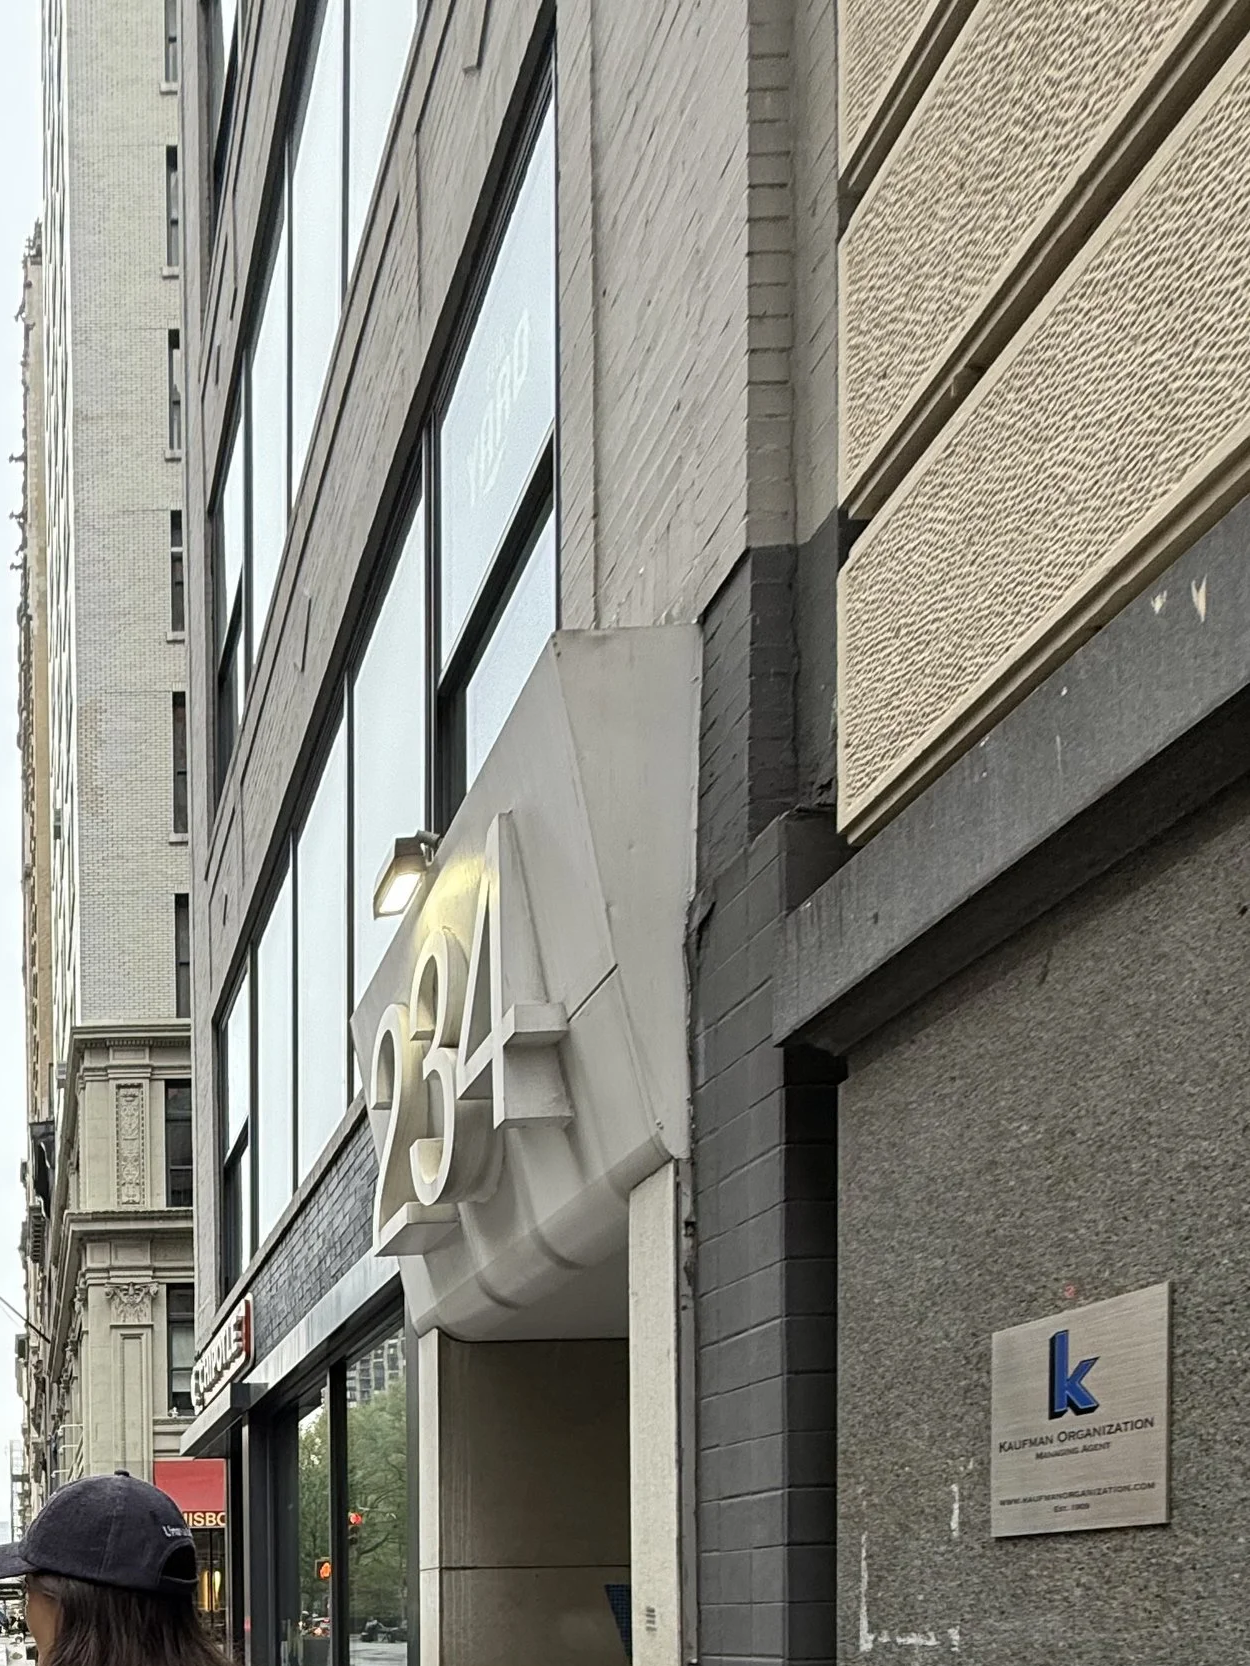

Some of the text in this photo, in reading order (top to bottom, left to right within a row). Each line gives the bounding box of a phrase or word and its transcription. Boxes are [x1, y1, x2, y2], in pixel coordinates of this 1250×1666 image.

[370, 812, 513, 1257] 234
[198, 1308, 244, 1393] CHIPOTLE
[999, 1417, 1154, 1453] KAUFMAN ORGANIZATION
